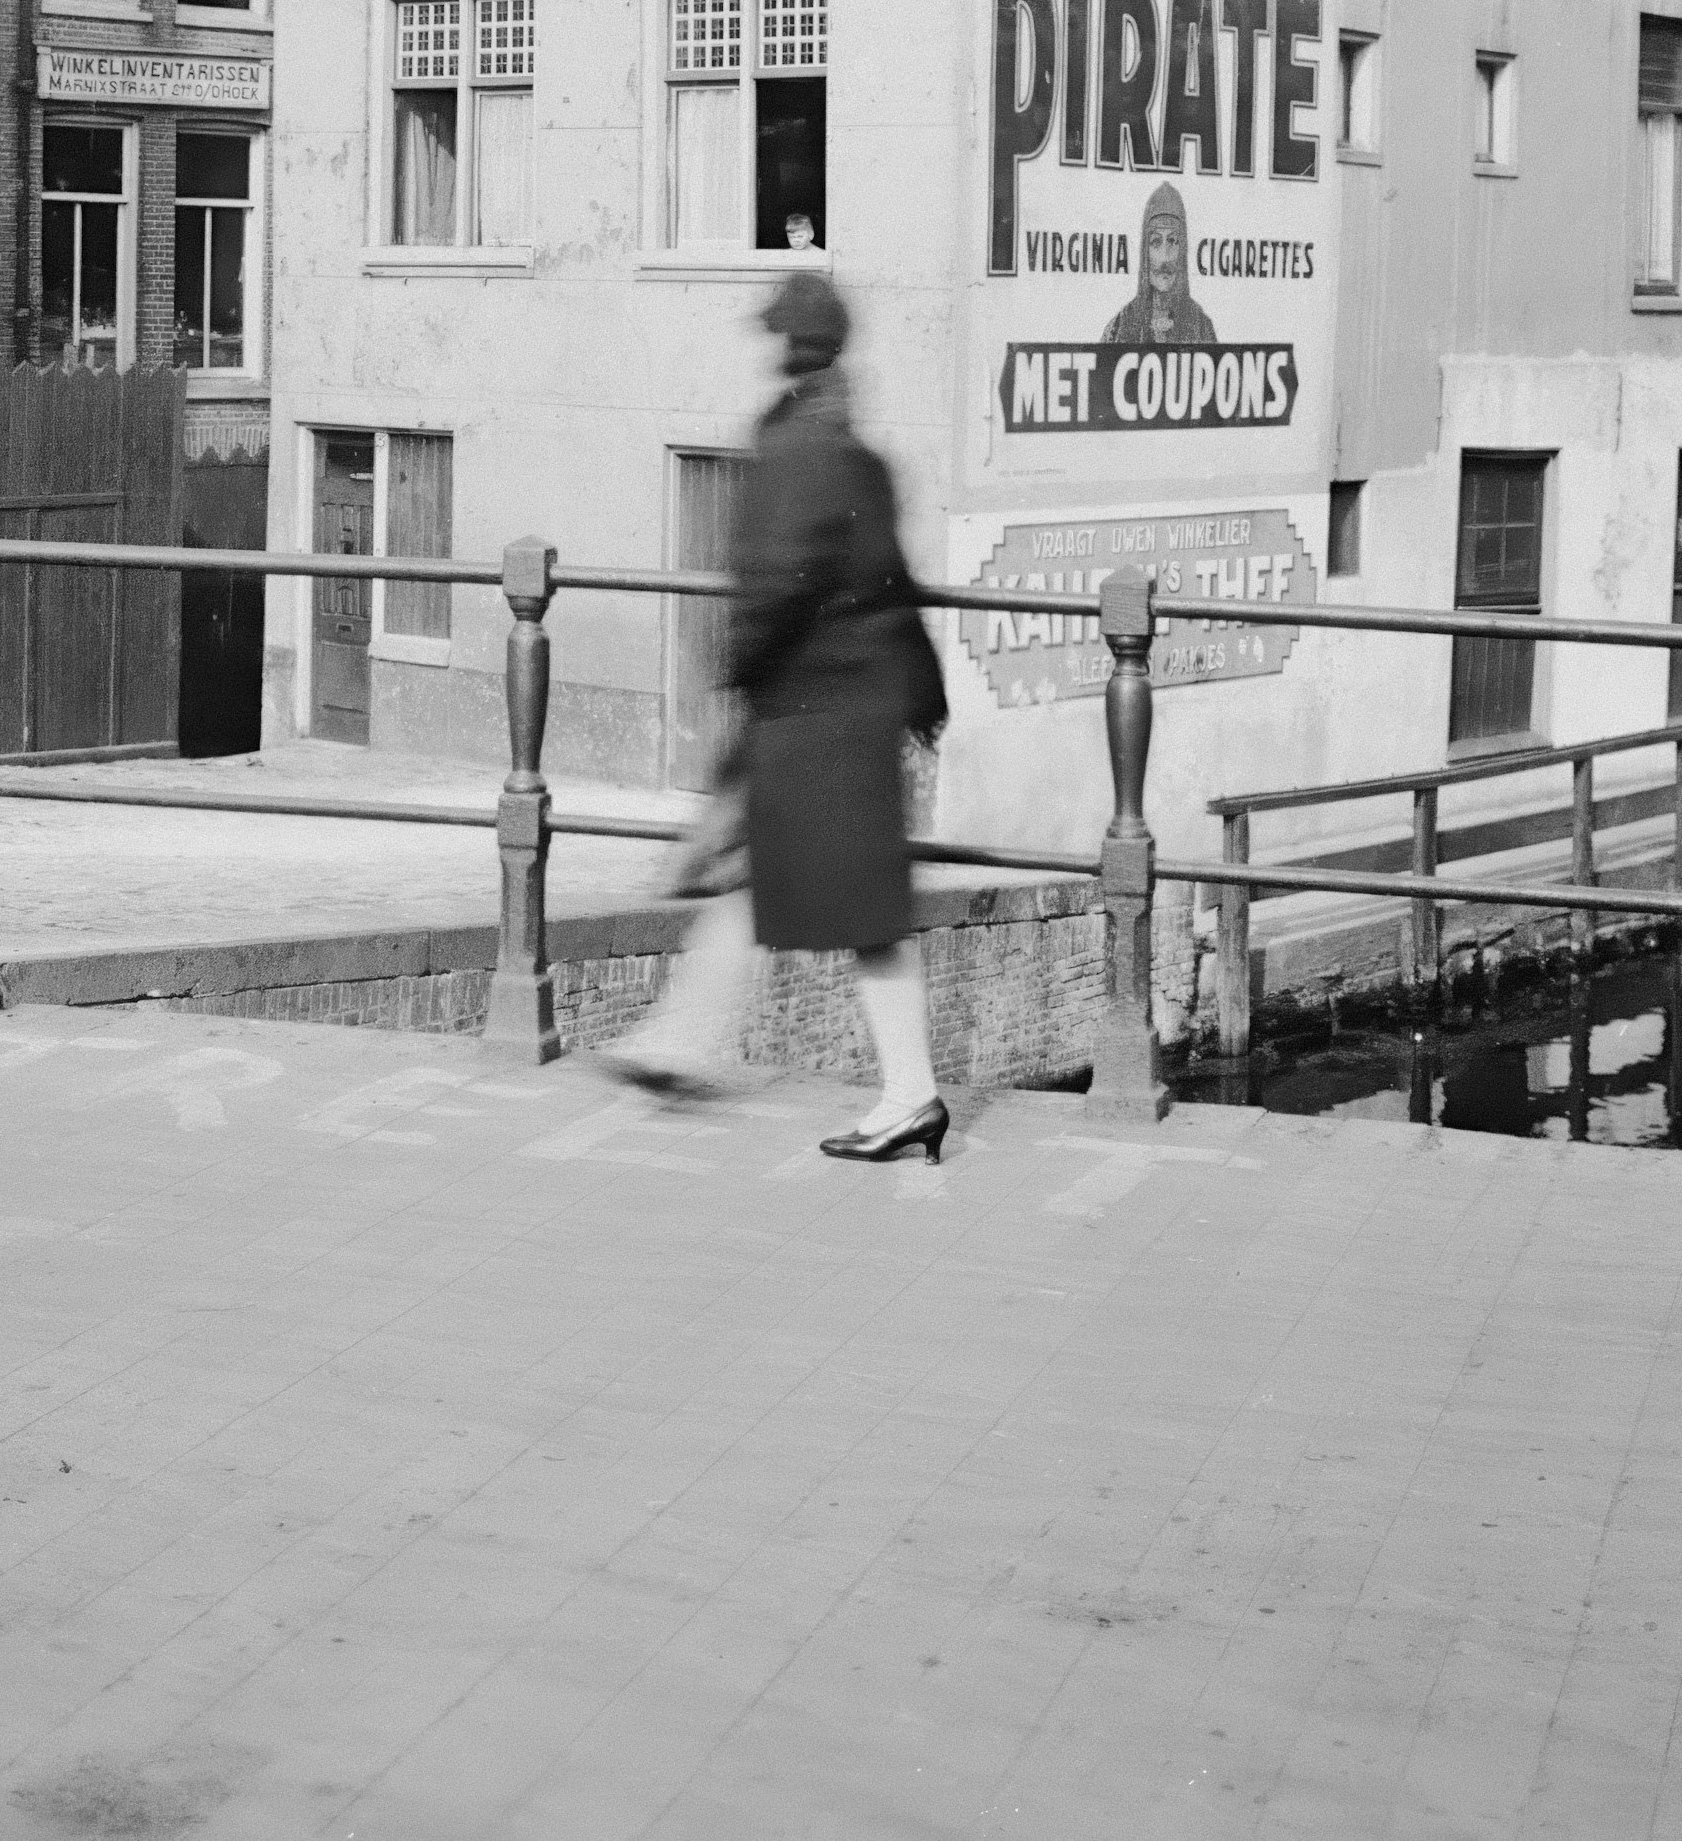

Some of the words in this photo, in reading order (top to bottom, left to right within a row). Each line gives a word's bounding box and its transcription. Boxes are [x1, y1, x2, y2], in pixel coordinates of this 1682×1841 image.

[50, 53, 260, 83] WINKELINVENTARISSEN
[1025, 231, 1130, 276] VIRGINIA
[1196, 237, 1315, 279] CIGARETTES
[1012, 350, 1098, 424] MET
[1112, 349, 1292, 422] COUPONS
[1031, 527, 1098, 559] VRAAGT
[1167, 518, 1252, 552] WINKELIER
